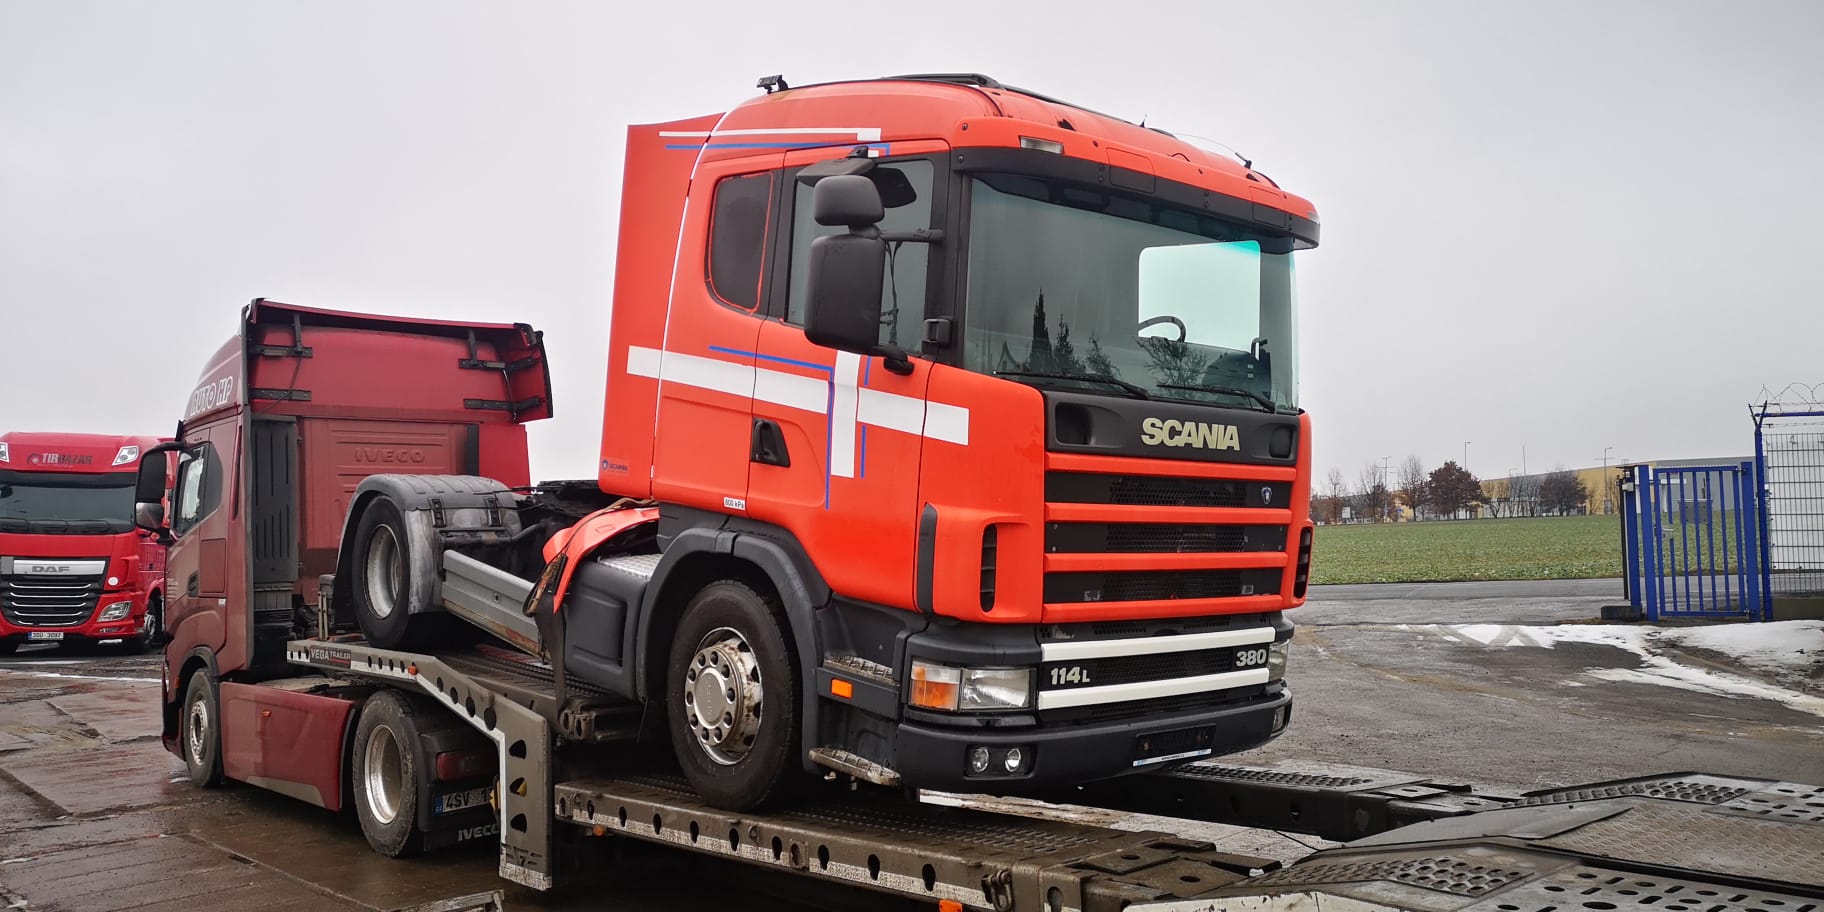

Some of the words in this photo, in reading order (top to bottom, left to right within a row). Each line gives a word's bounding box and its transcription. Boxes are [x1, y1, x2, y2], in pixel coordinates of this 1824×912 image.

[216, 376, 233, 406] HP
[1141, 417, 1240, 451] SCANIA
[354, 448, 425, 463] IVECO
[311, 648, 329, 660] VEGA
[330, 651, 351, 660] TRAILER
[1236, 649, 1267, 667] 380
[446, 791, 470, 809] 4SV
